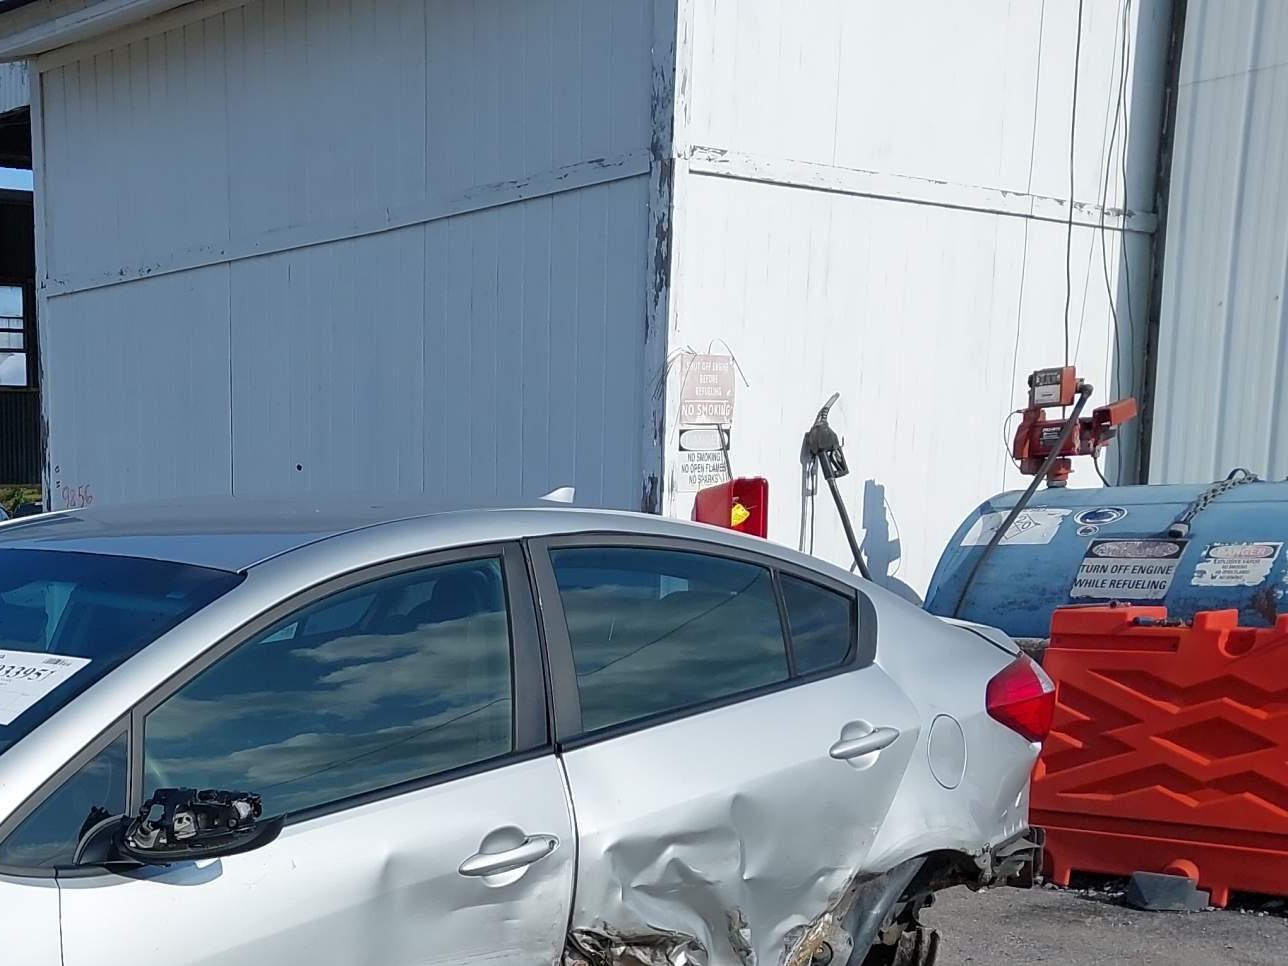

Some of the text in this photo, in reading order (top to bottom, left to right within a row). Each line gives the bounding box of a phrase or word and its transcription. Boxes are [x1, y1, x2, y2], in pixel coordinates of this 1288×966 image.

[681, 403, 732, 417] NO SMOKING
[687, 452, 721, 462] NO SMOKING
[681, 463, 689, 473] NO
[690, 463, 704, 473] OPEN
[689, 474, 697, 485] NO
[1080, 564, 1174, 575] TURN OFF ENGINE
[1074, 578, 1167, 590] WHILE REFUELING
